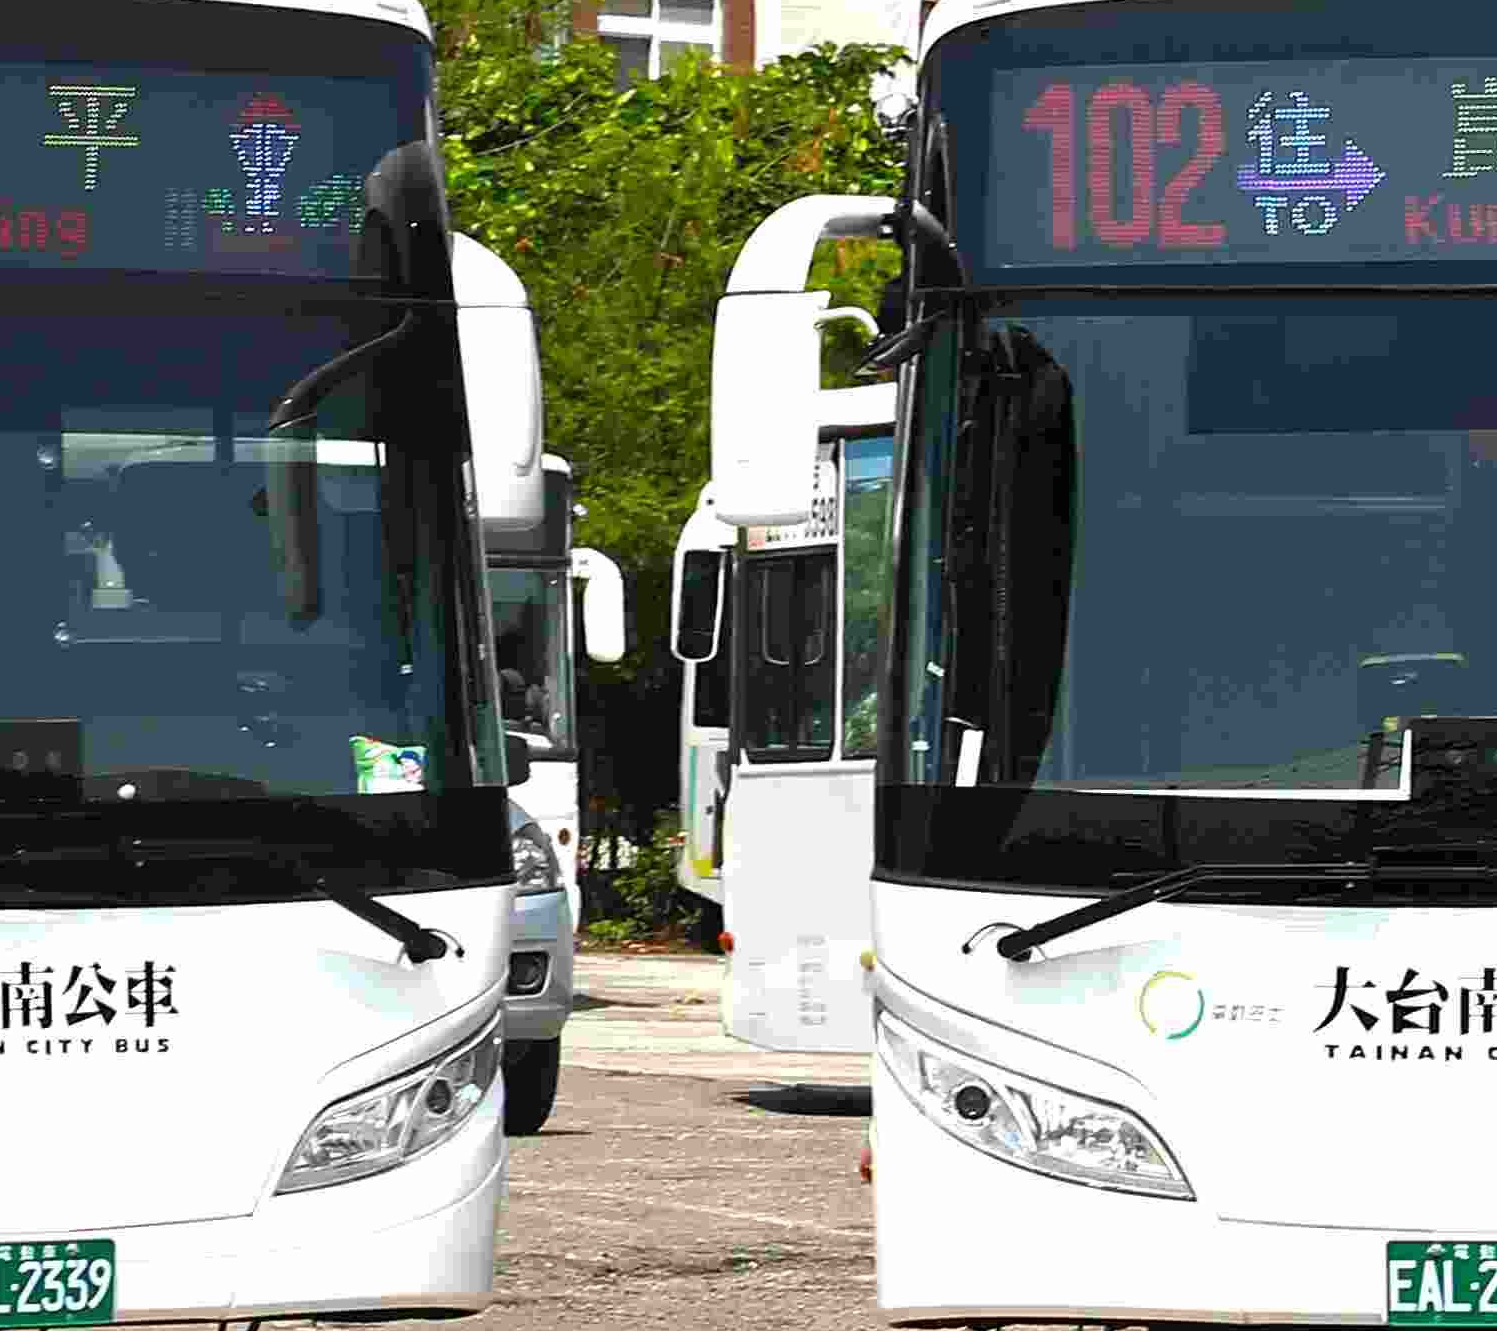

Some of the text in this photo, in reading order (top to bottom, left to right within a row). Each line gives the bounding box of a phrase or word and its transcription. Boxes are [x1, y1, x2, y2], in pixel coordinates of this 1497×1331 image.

[1022, 81, 1227, 250] 102
[1255, 195, 1338, 236] TO
[26, 1038, 93, 1055] CITY
[115, 1038, 171, 1054] BUS
[1324, 1044, 1463, 1061] TAINAN
